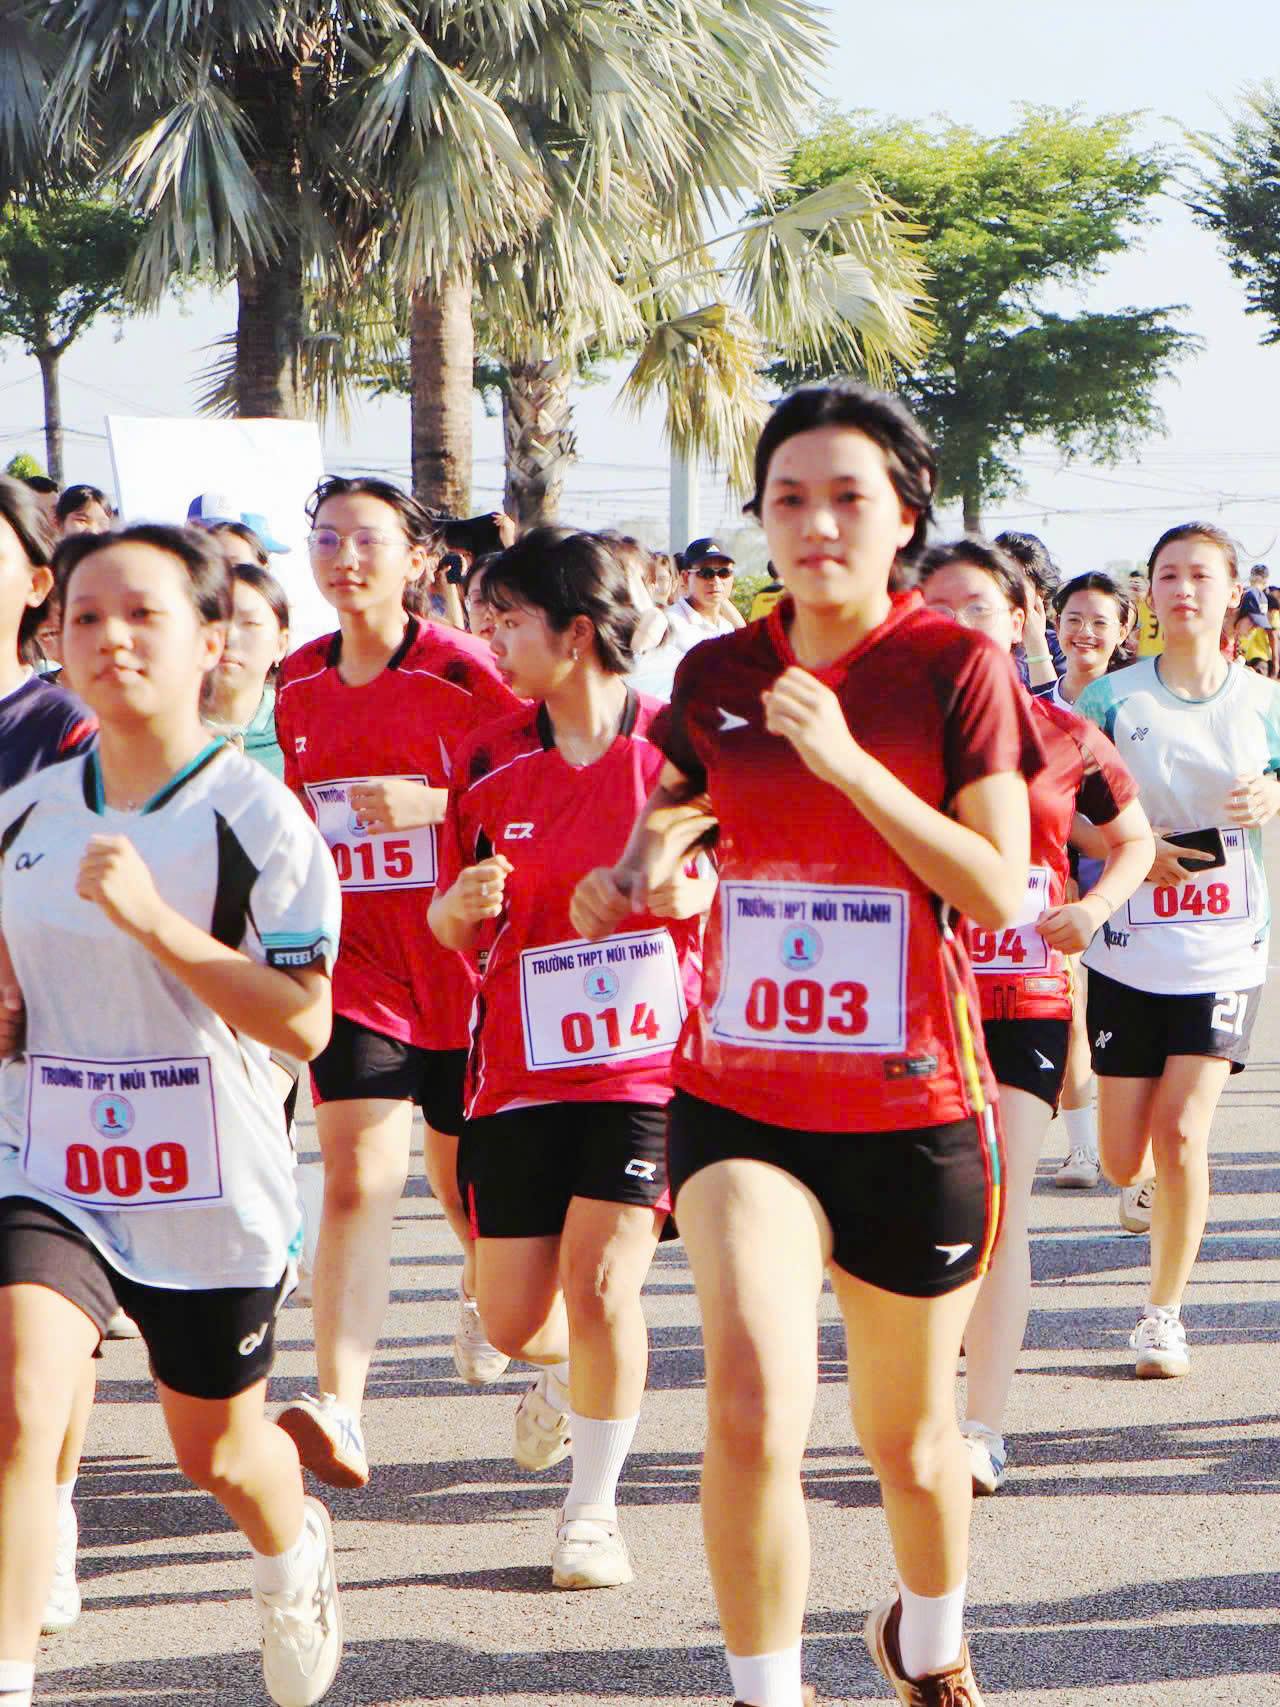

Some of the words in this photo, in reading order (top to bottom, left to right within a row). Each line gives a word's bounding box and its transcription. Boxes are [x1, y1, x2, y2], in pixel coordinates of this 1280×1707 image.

[329, 839, 414, 881] 015
[812, 899, 837, 921] NÚI
[842, 900, 891, 923] THÀNH
[1153, 883, 1231, 917] 048
[532, 954, 574, 975] TRƯỜNG
[577, 951, 603, 967] THPT
[606, 944, 626, 963] NÚI
[629, 941, 664, 959] THÀNH
[972, 928, 1027, 963] 94
[745, 977, 869, 1036] 093
[561, 1002, 661, 1053] 014
[41, 1063, 84, 1089] TRƯỜNG
[87, 1071, 114, 1091] THPT
[119, 1069, 146, 1091] NÚI
[150, 1065, 200, 1088] THÀNH
[65, 1142, 189, 1197] 009
